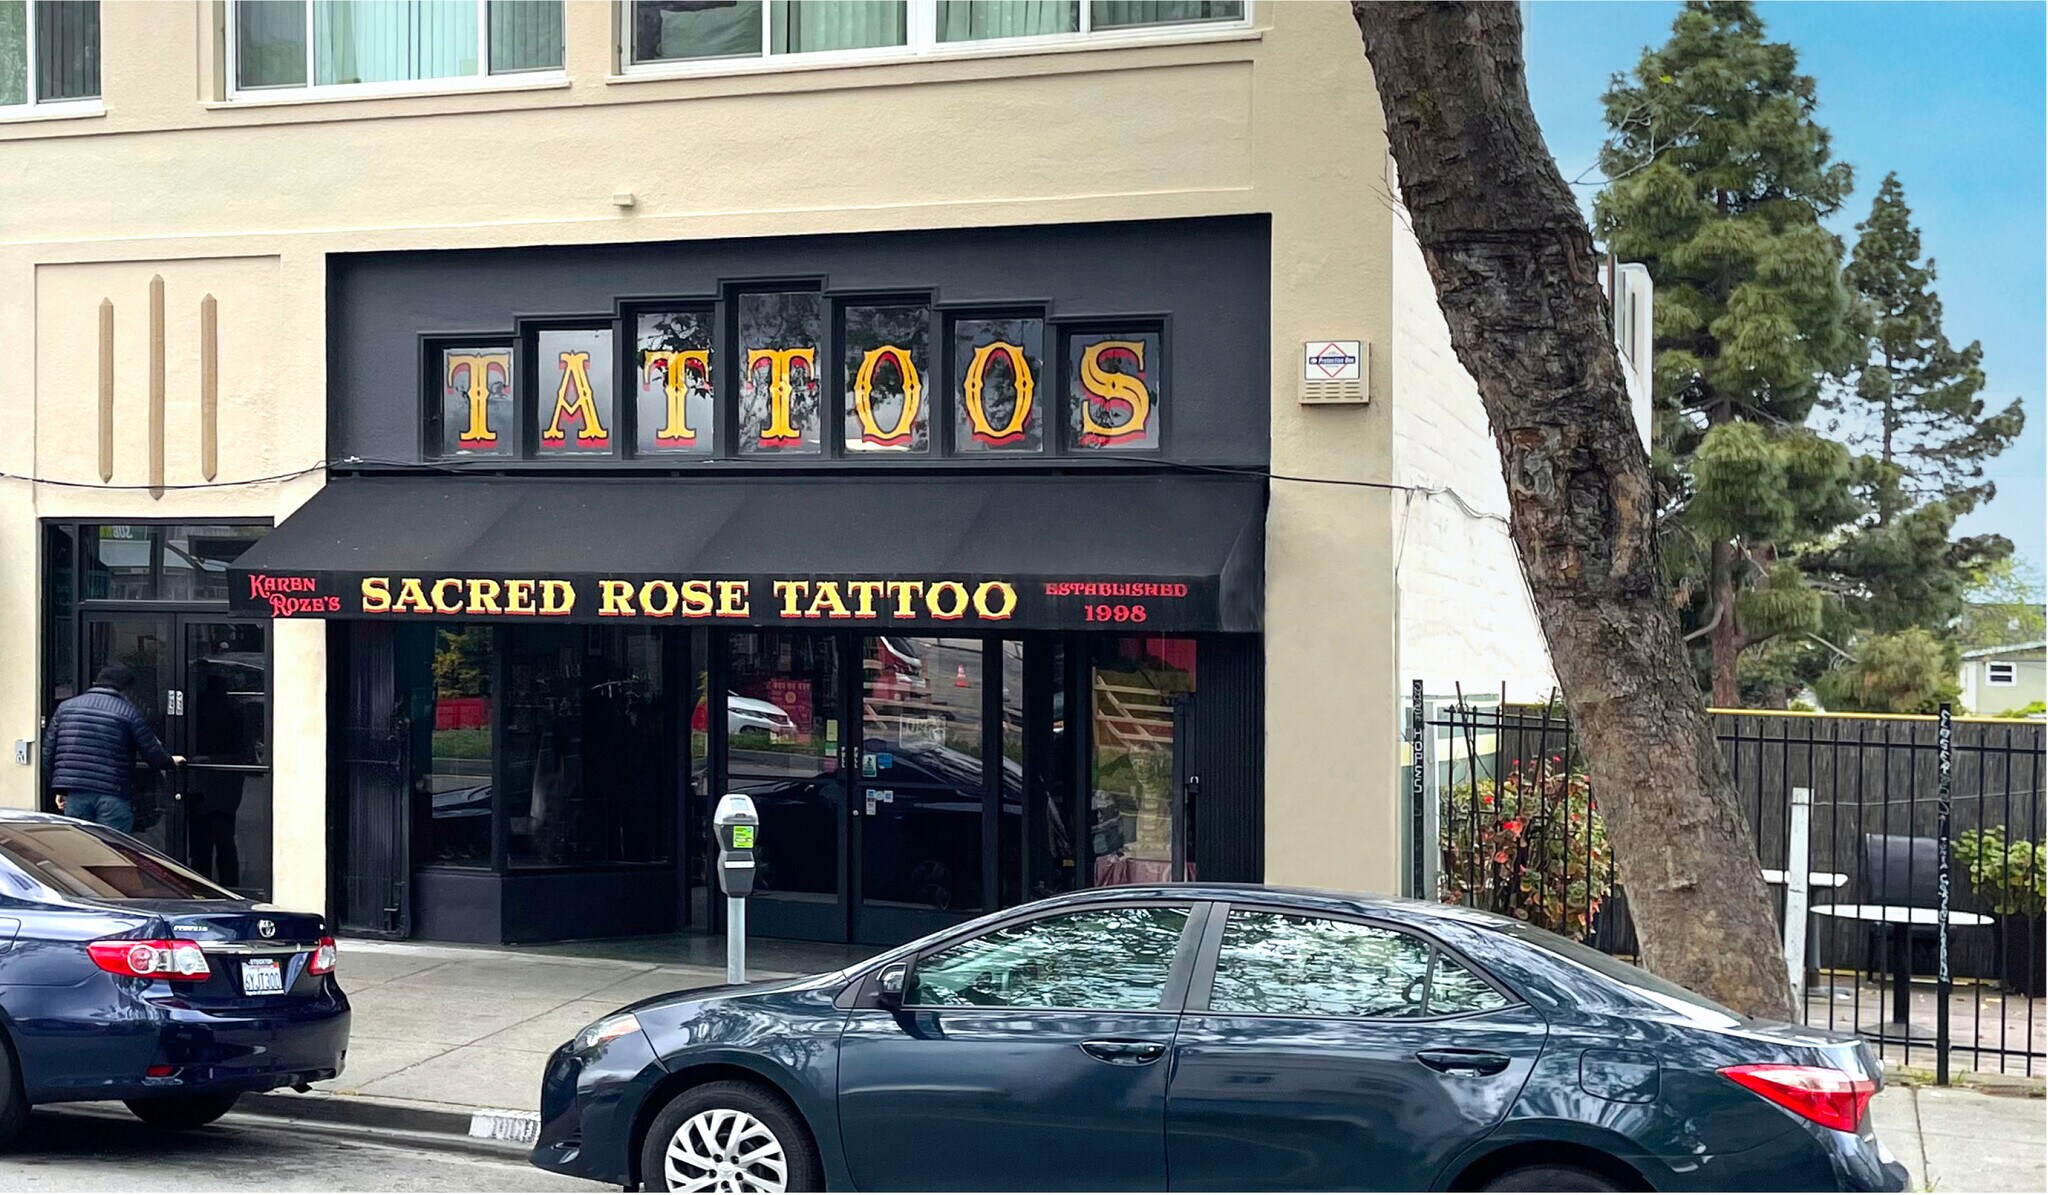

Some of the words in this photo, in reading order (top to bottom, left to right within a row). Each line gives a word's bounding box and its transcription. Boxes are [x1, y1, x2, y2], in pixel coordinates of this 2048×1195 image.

[446, 340, 1149, 449] TATTOOS
[248, 575, 316, 599] KAREN
[1045, 582, 1188, 597] ESTABLISHED
[269, 594, 341, 617] ROZE'S
[361, 578, 576, 615] SACRED
[598, 580, 750, 617] ROSE
[773, 581, 1018, 620] TATTOO
[1084, 604, 1148, 622] 1998
